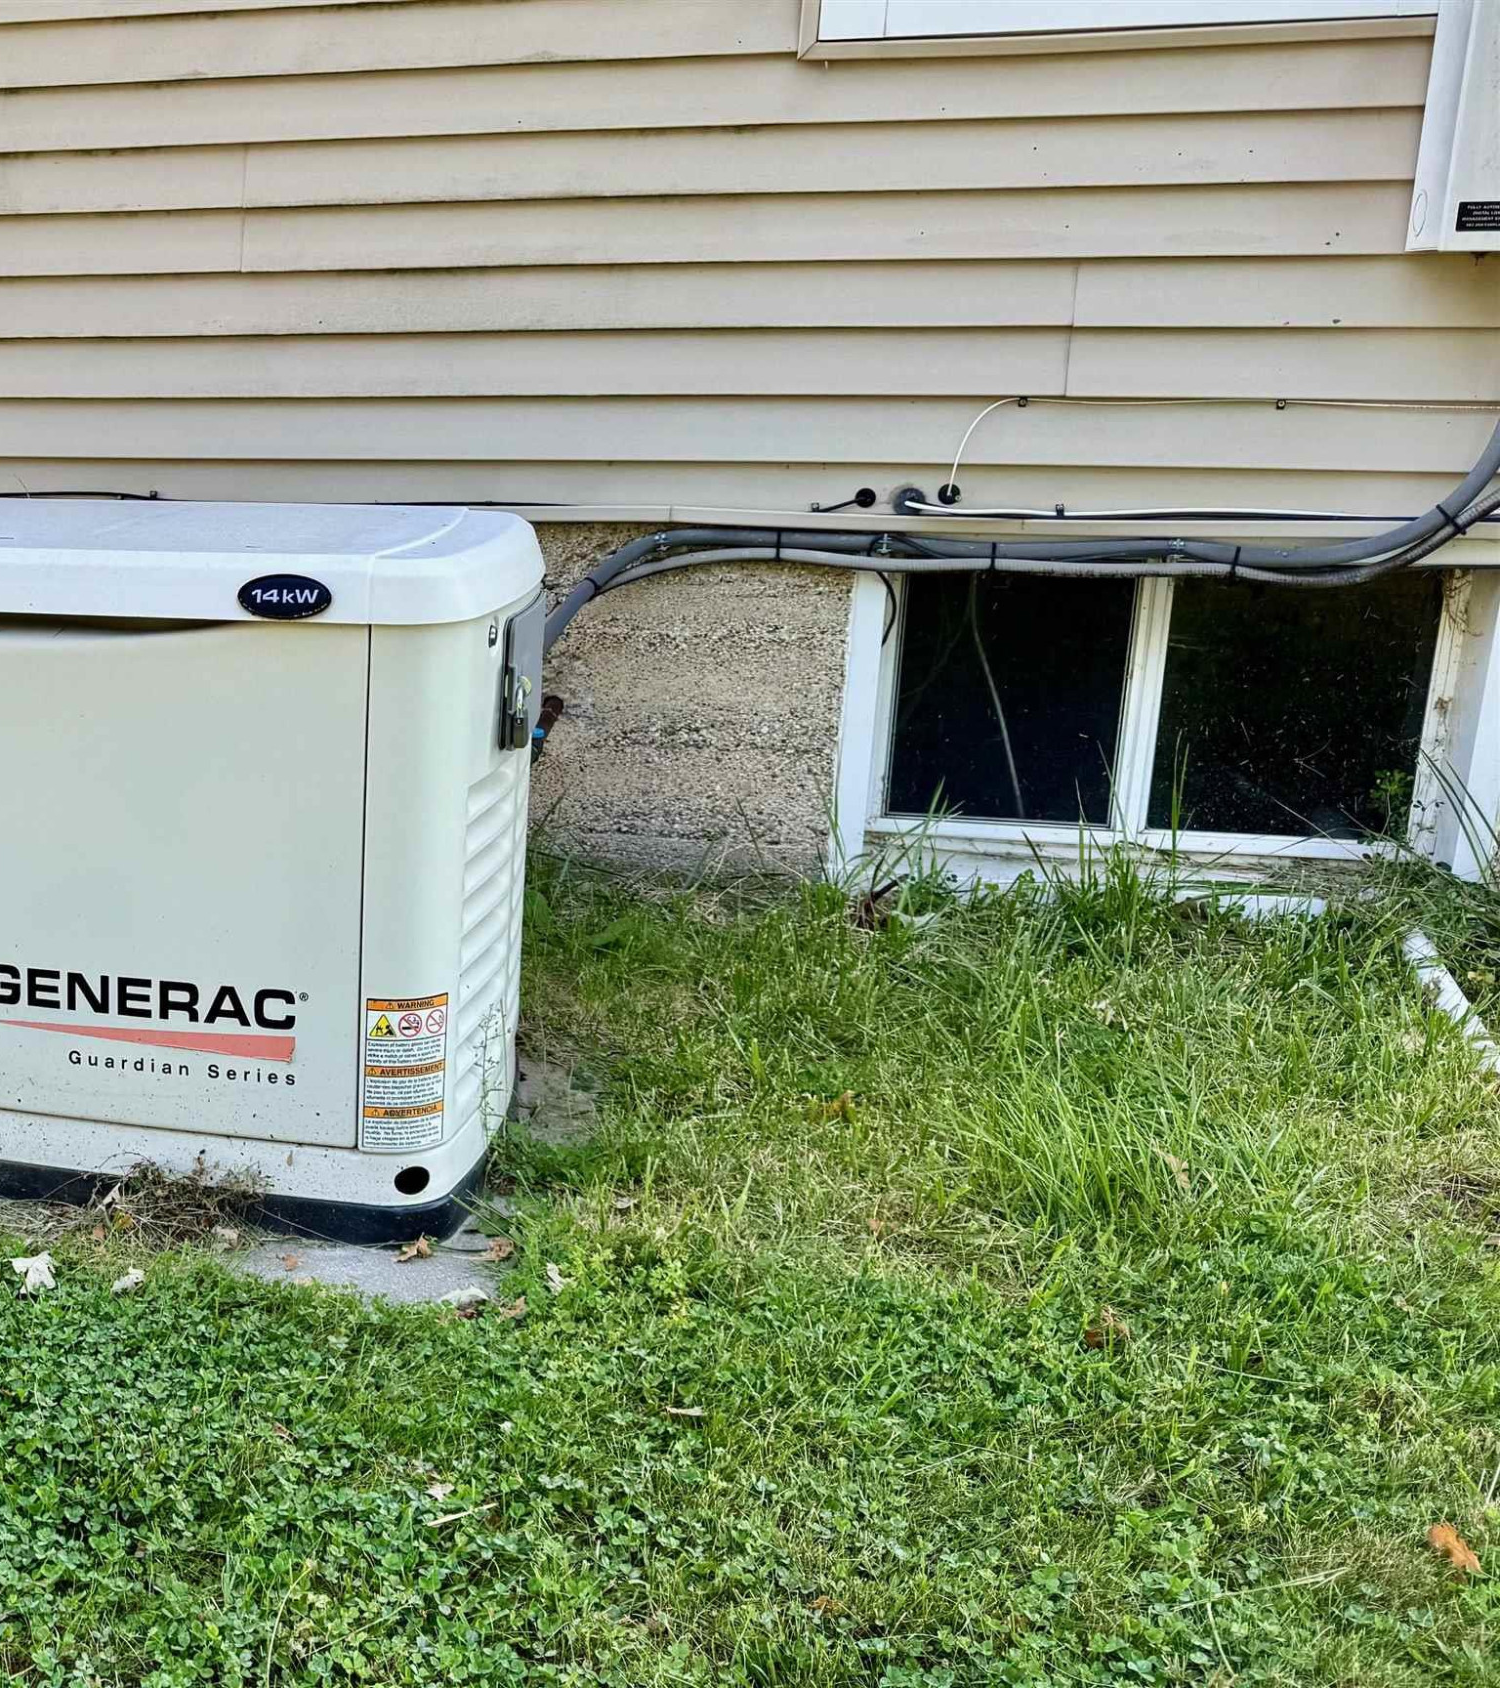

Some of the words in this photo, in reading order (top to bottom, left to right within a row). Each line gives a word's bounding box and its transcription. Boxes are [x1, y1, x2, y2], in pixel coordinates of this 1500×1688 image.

[251, 589, 319, 604] 14kW
[397, 999, 435, 1009] WARNING
[68, 1050, 190, 1077] Guardian
[207, 1064, 296, 1086] Series
[380, 1062, 442, 1076] AVERTISSEMENT
[383, 1104, 438, 1117] ADVERTENCIA
